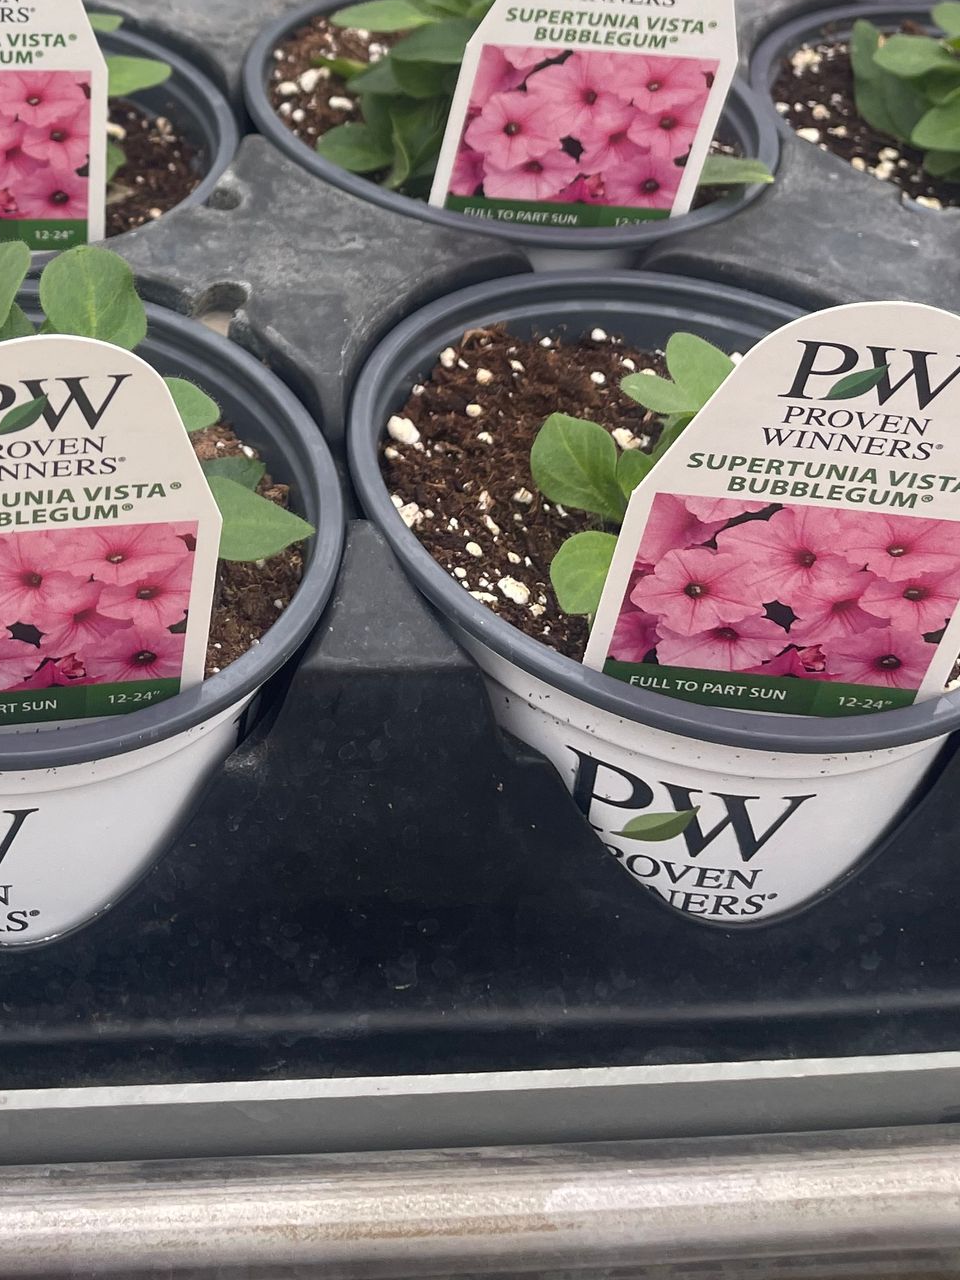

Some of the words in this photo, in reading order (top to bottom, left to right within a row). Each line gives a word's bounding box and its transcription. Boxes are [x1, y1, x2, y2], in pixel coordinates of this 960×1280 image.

[505, 7, 639, 29] SUPERTUNIA
[463, 207, 494, 220] FULL
[497, 209, 512, 220] TO
[516, 211, 547, 223] PART
[551, 213, 578, 225] SUN
[777, 340, 960, 410] PW
[781, 405, 933, 436] PROVEN
[687, 452, 877, 484] SUPERTUNIA
[629, 675, 671, 690] FULL
[675, 679, 698, 692] TO
[703, 682, 746, 697] PART
[750, 686, 786, 701] SUN
[21, 699, 57, 713] SUN
[566, 744, 817, 862] PW
